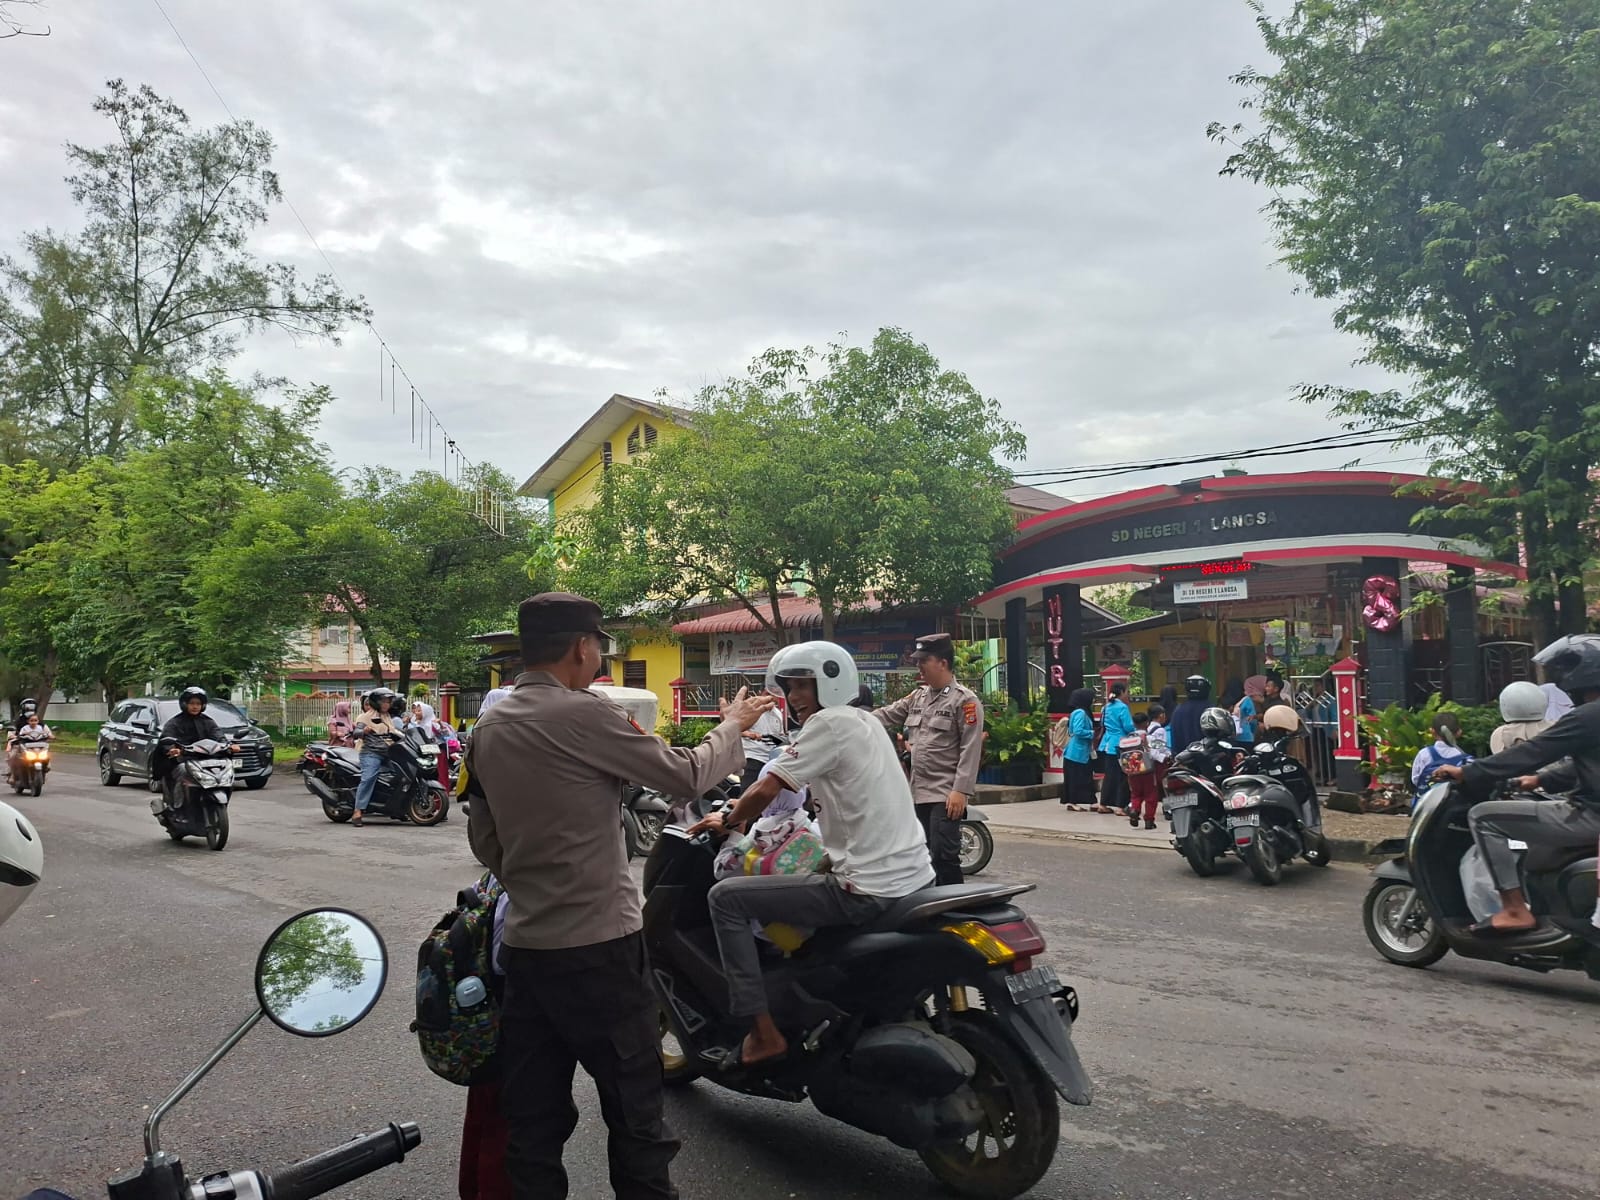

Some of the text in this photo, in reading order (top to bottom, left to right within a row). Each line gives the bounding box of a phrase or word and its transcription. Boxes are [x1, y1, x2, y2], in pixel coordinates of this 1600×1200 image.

[1111, 529, 1130, 542] SD
[1133, 521, 1186, 540] NEGERI
[1210, 511, 1277, 530] LANGSA
